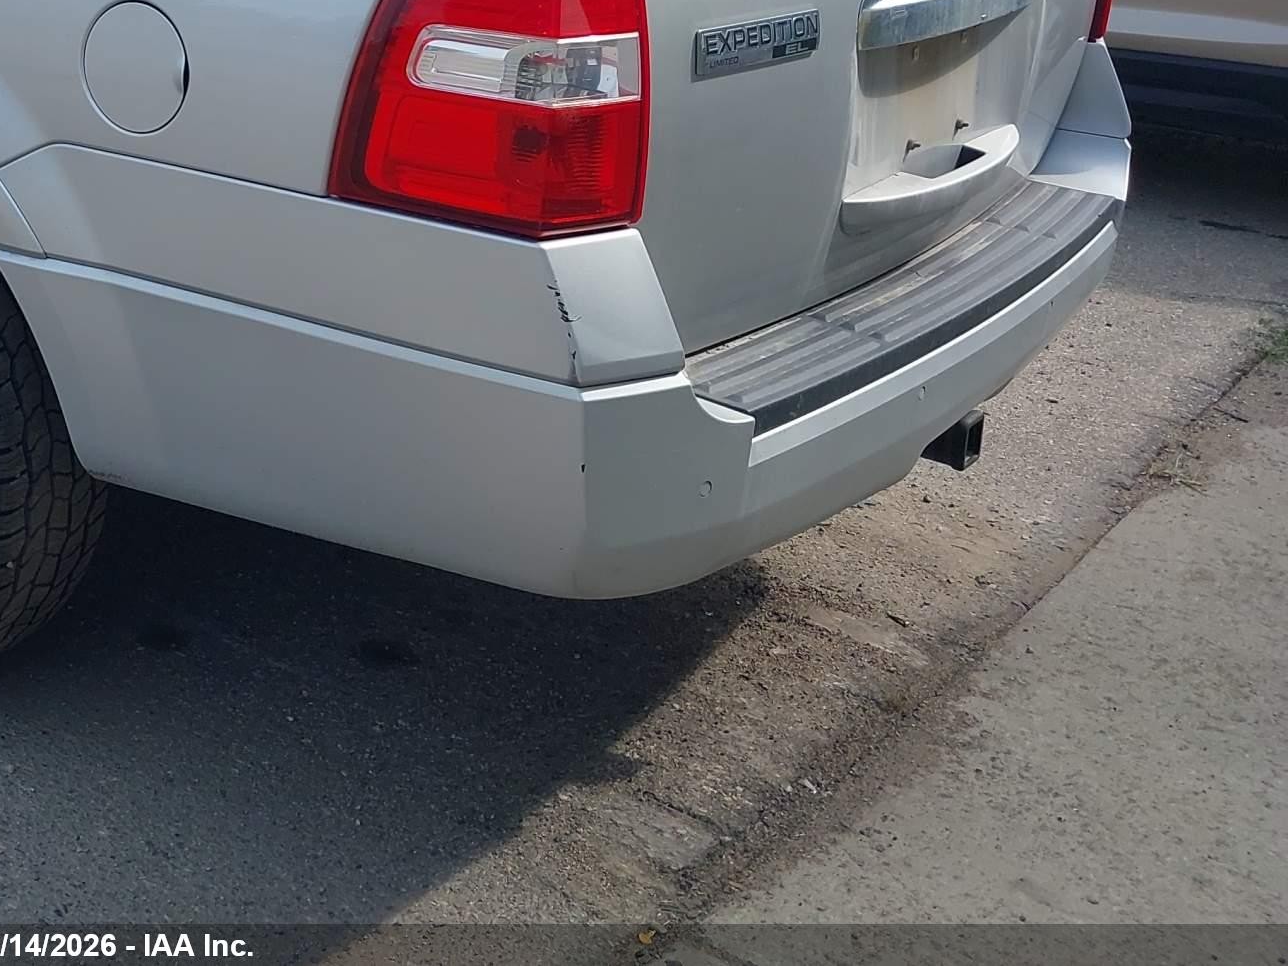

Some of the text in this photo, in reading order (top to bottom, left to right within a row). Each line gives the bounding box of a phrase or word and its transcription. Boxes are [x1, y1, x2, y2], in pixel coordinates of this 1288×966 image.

[703, 13, 819, 55] EXPEDITION
[784, 42, 809, 55] EL
[709, 56, 739, 68] LIMITED
